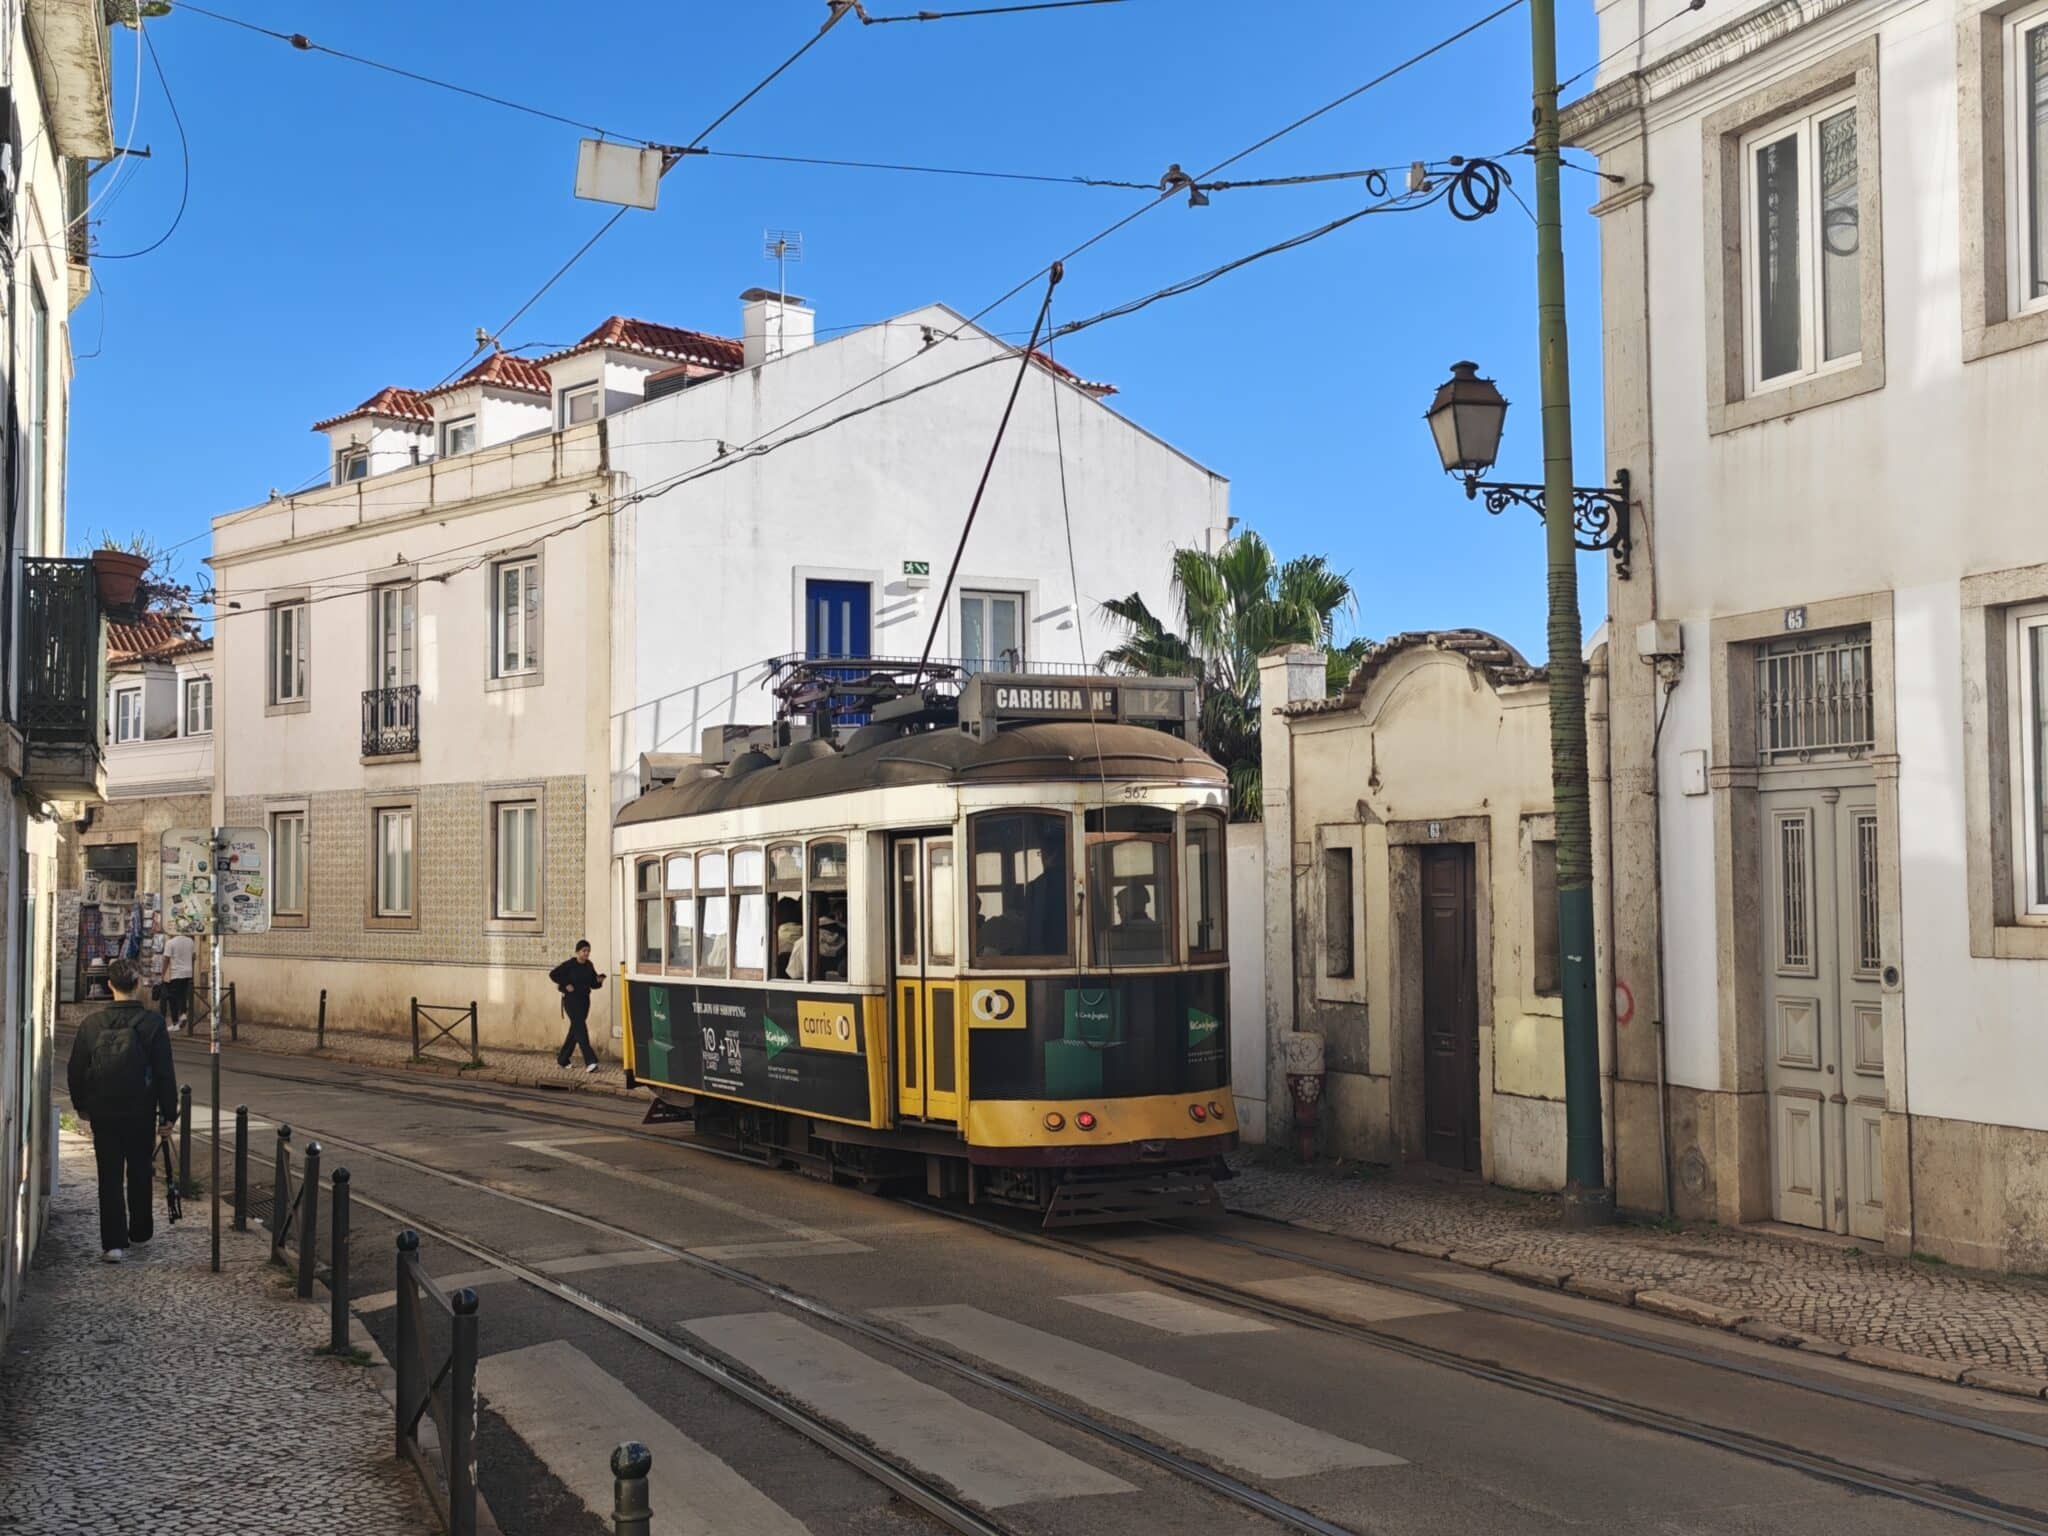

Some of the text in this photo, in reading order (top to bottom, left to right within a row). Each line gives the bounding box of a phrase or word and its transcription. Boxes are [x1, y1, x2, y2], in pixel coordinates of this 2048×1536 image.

[1788, 609, 1803, 630] 65
[996, 687, 1083, 710] CARREIRA
[1142, 690, 1169, 713] 12
[803, 1010, 832, 1036] carris
[724, 1036, 742, 1058] TAX
